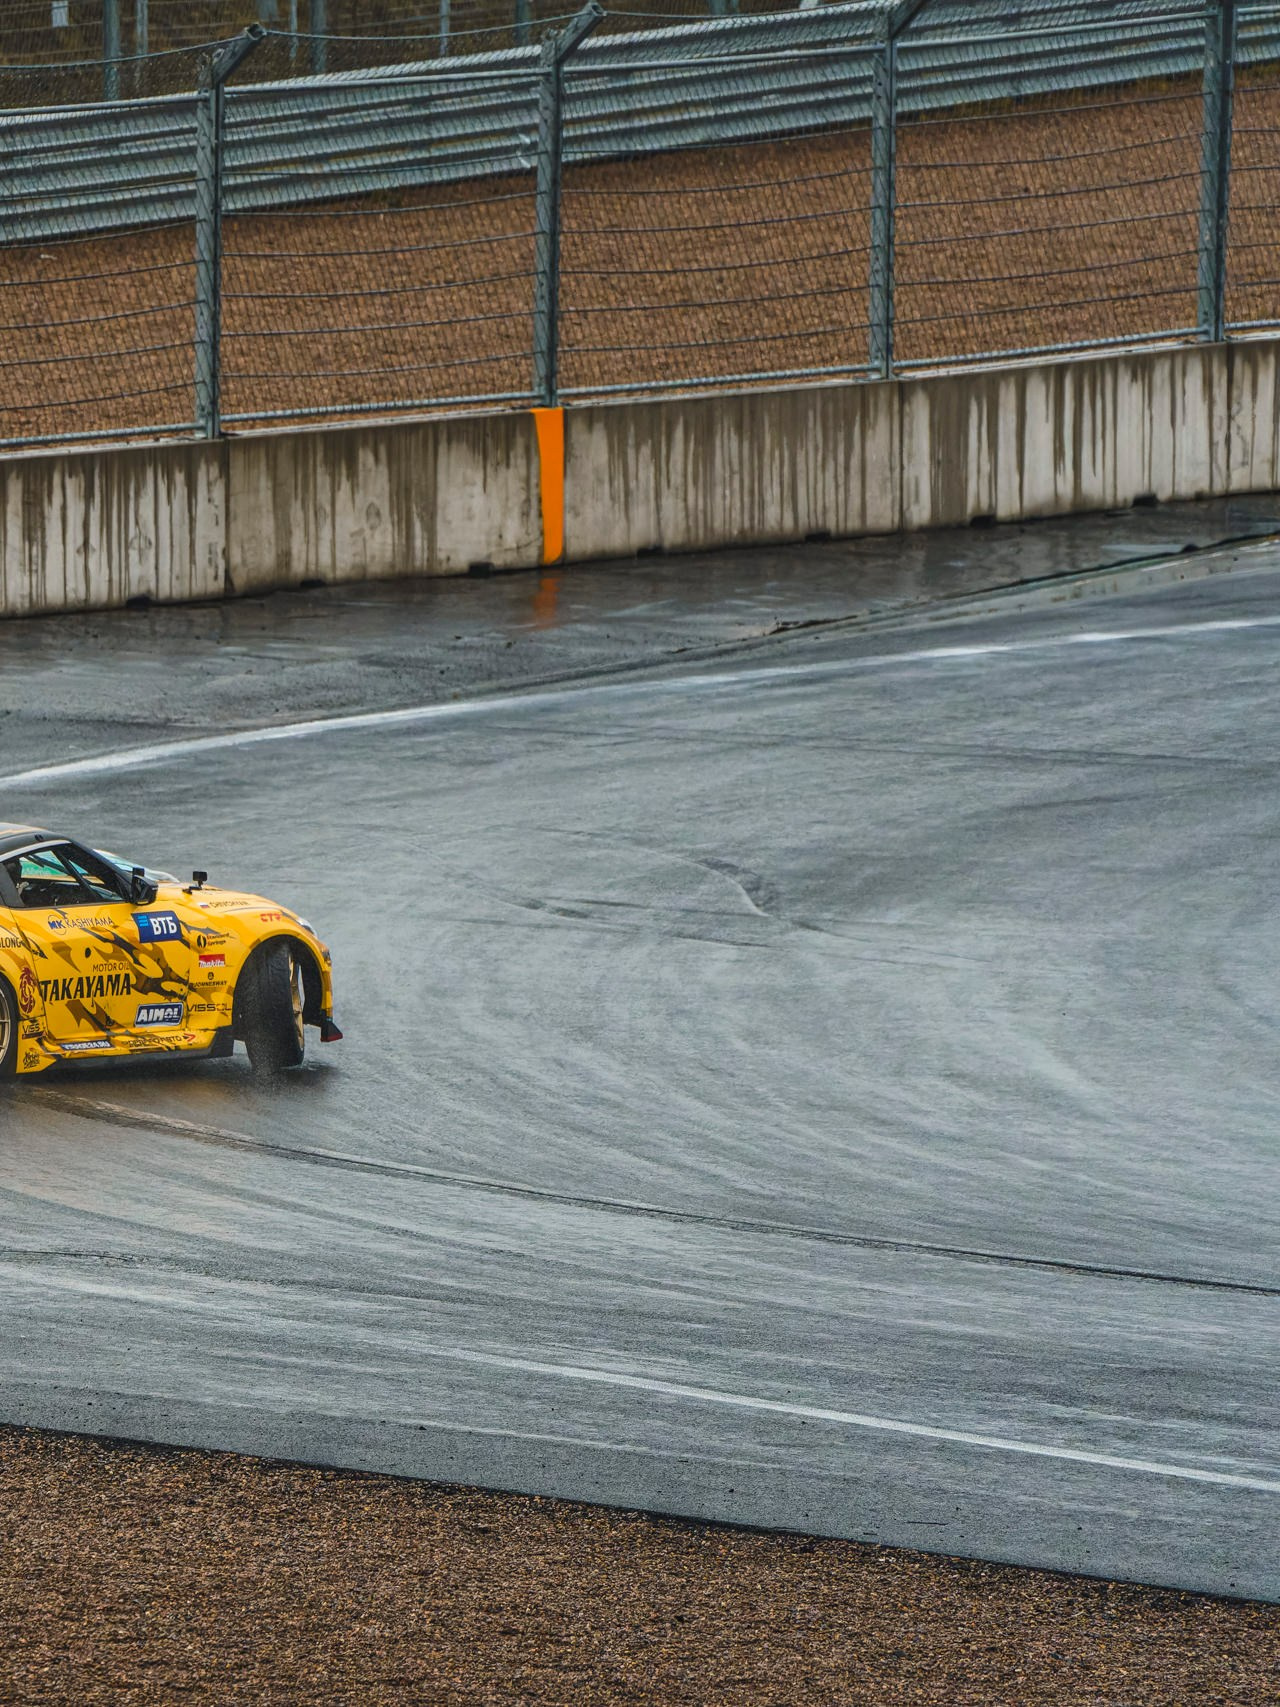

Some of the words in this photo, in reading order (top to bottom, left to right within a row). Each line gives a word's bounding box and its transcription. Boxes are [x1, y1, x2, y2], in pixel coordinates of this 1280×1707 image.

[66, 917, 114, 928] KASHIYAMA
[150, 917, 178, 935] ВТБ
[92, 963, 117, 972] MOTOR
[118, 961, 130, 971] OIL
[39, 973, 132, 1002] TAKAYAMA
[137, 1007, 180, 1022] AIMOL
